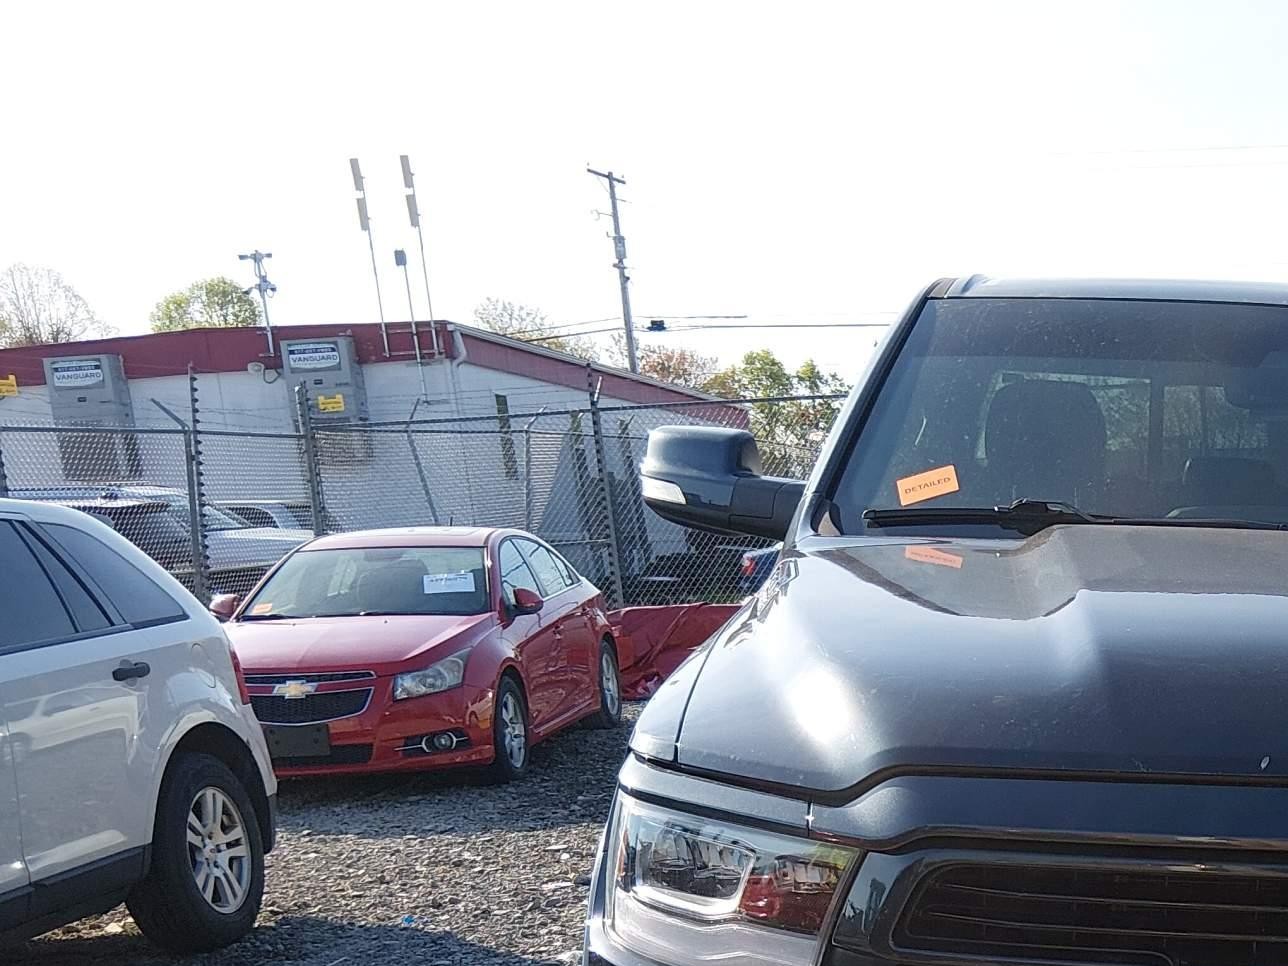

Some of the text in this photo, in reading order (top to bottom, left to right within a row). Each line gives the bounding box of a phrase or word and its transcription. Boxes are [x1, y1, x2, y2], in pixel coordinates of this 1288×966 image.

[291, 353, 338, 363] VANGUARD
[55, 371, 101, 381] VANGUARD
[904, 477, 951, 494] DETAILED
